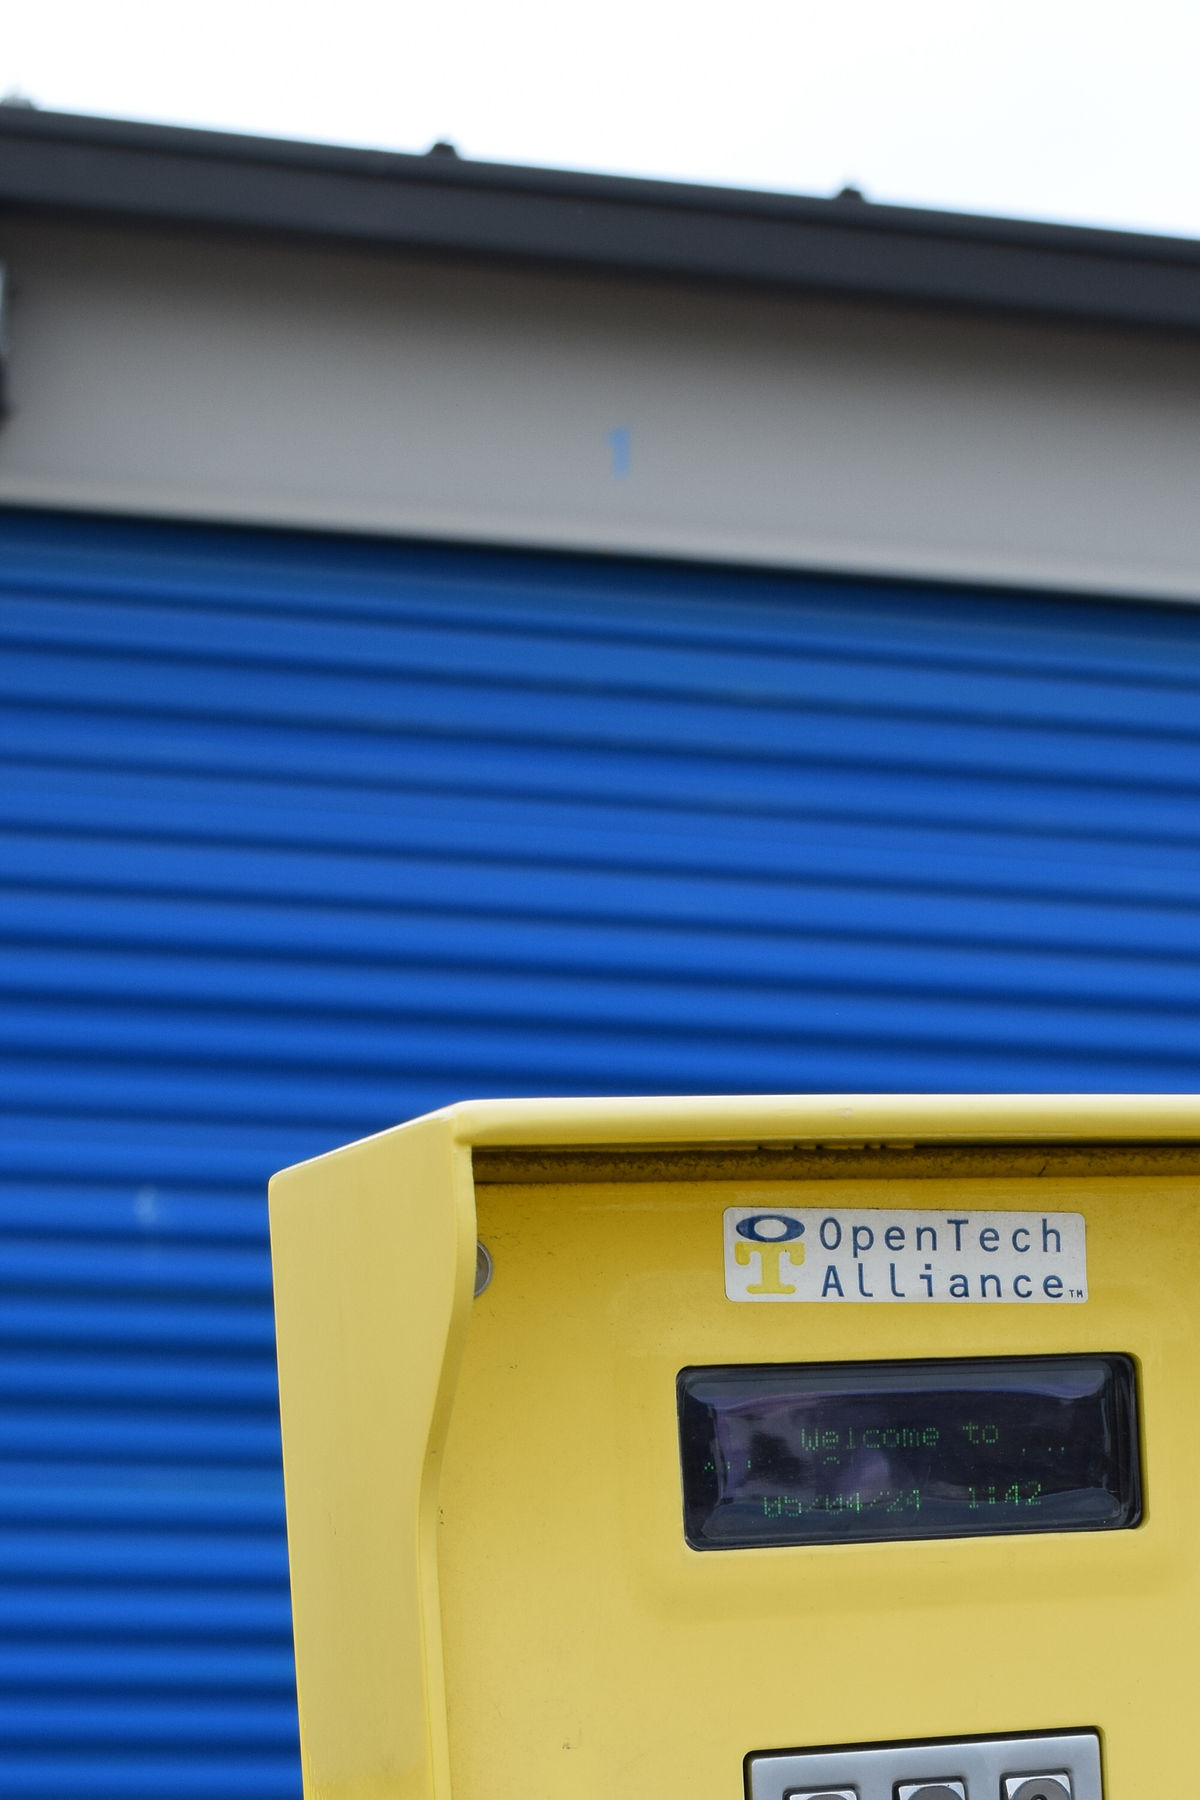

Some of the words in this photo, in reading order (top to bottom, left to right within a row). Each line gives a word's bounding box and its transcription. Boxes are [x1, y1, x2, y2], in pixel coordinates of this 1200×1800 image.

[819, 1216, 1062, 1259] OpenTech
[820, 1262, 1065, 1299] Alliance
[800, 1426, 940, 1451] Welcome
[962, 1421, 1000, 1445] to
[967, 1480, 1042, 1509] 1:42
